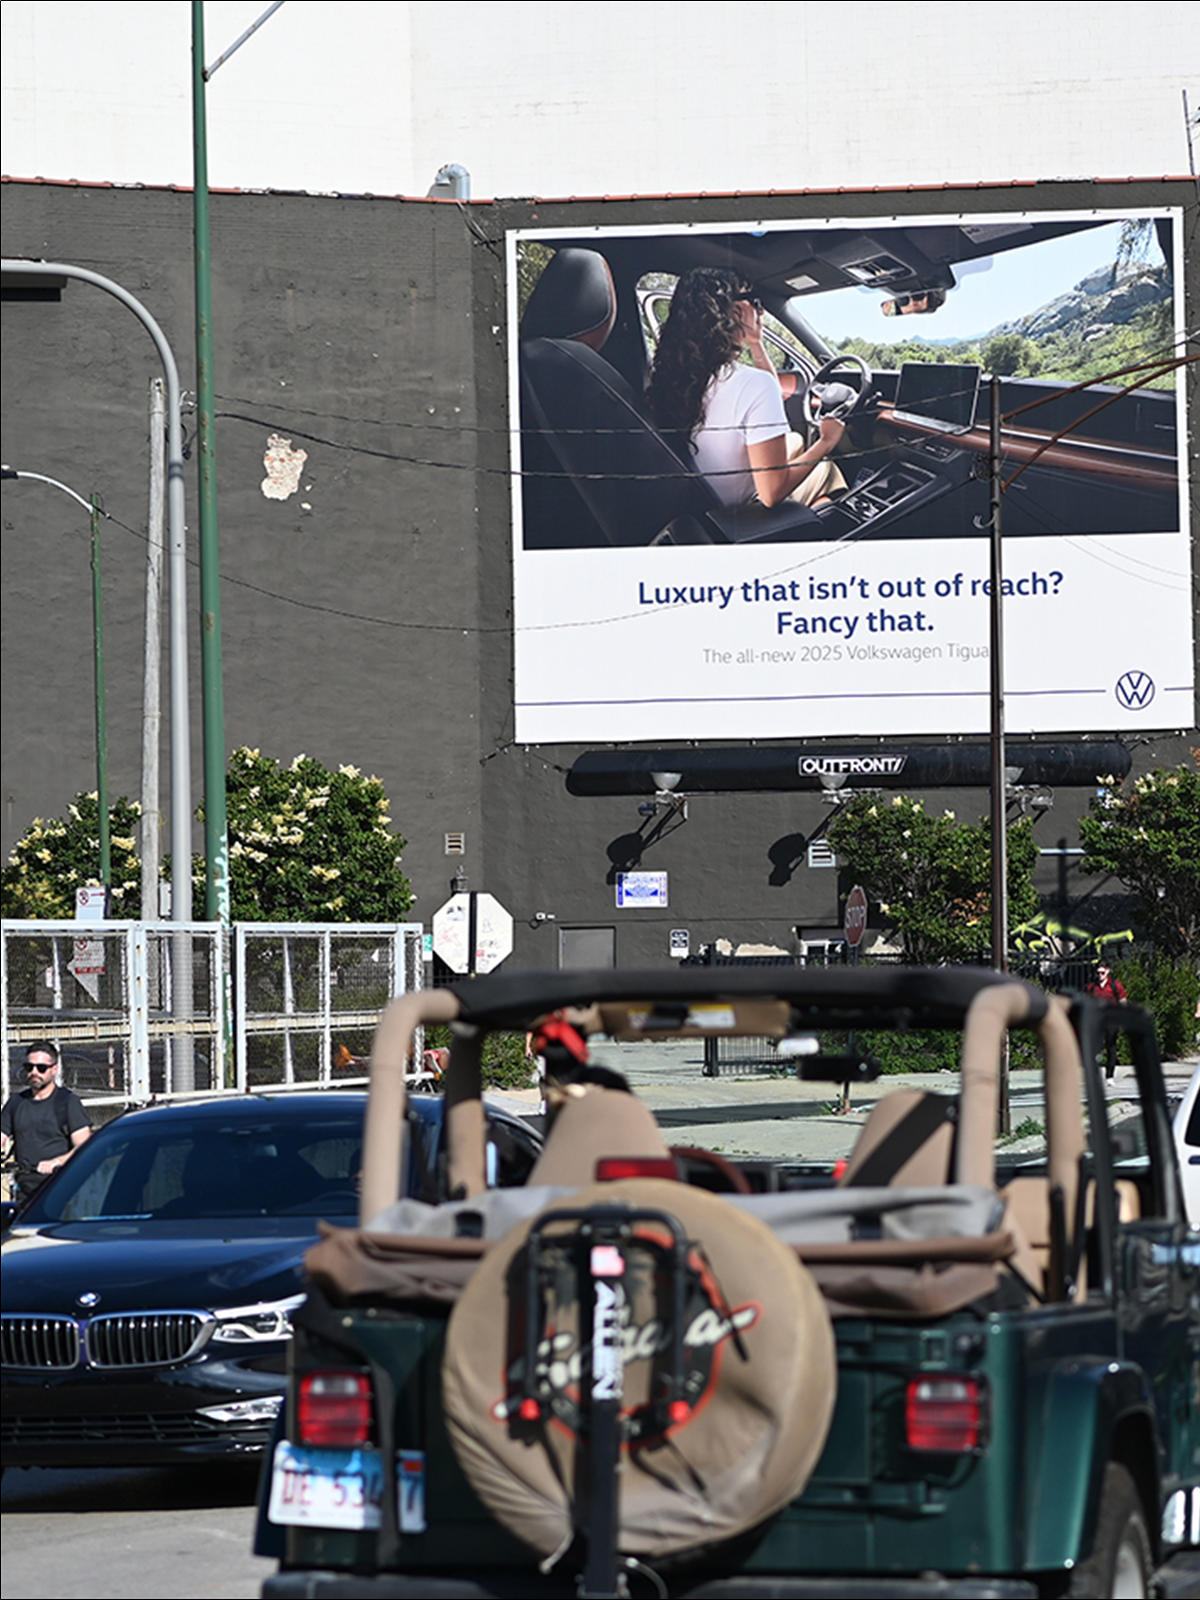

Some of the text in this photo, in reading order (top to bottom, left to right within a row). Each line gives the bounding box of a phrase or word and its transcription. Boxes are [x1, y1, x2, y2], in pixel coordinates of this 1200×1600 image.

[638, 570, 1064, 610] Luxury that isn't out of reach?
[776, 608, 935, 639] Fancy that.
[702, 642, 990, 664] The all-new 2025 Volkswagen Tigua
